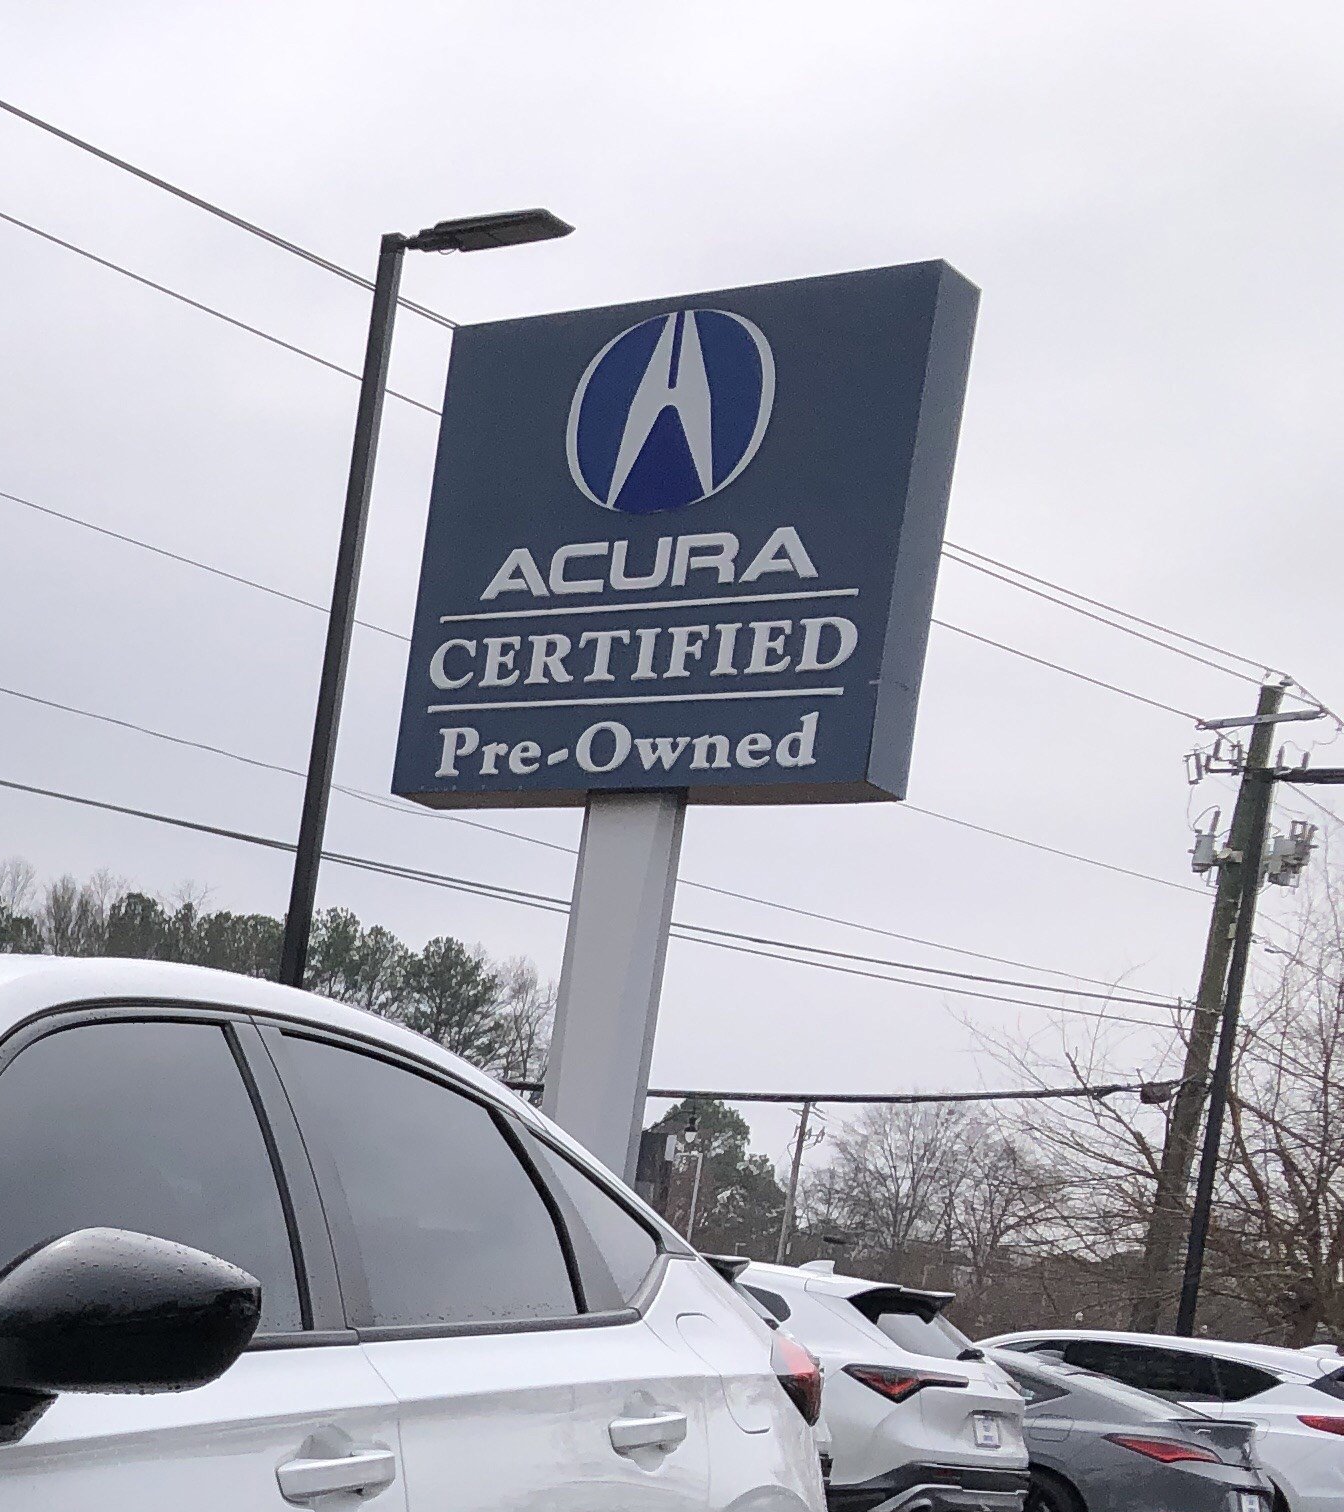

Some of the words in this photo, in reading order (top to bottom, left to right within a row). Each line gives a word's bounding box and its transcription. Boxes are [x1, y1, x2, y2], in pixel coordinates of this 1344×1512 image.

[479, 526, 819, 602] ACURA
[428, 615, 859, 690] CERTIFIED
[434, 710, 821, 779] Pre-Owned
